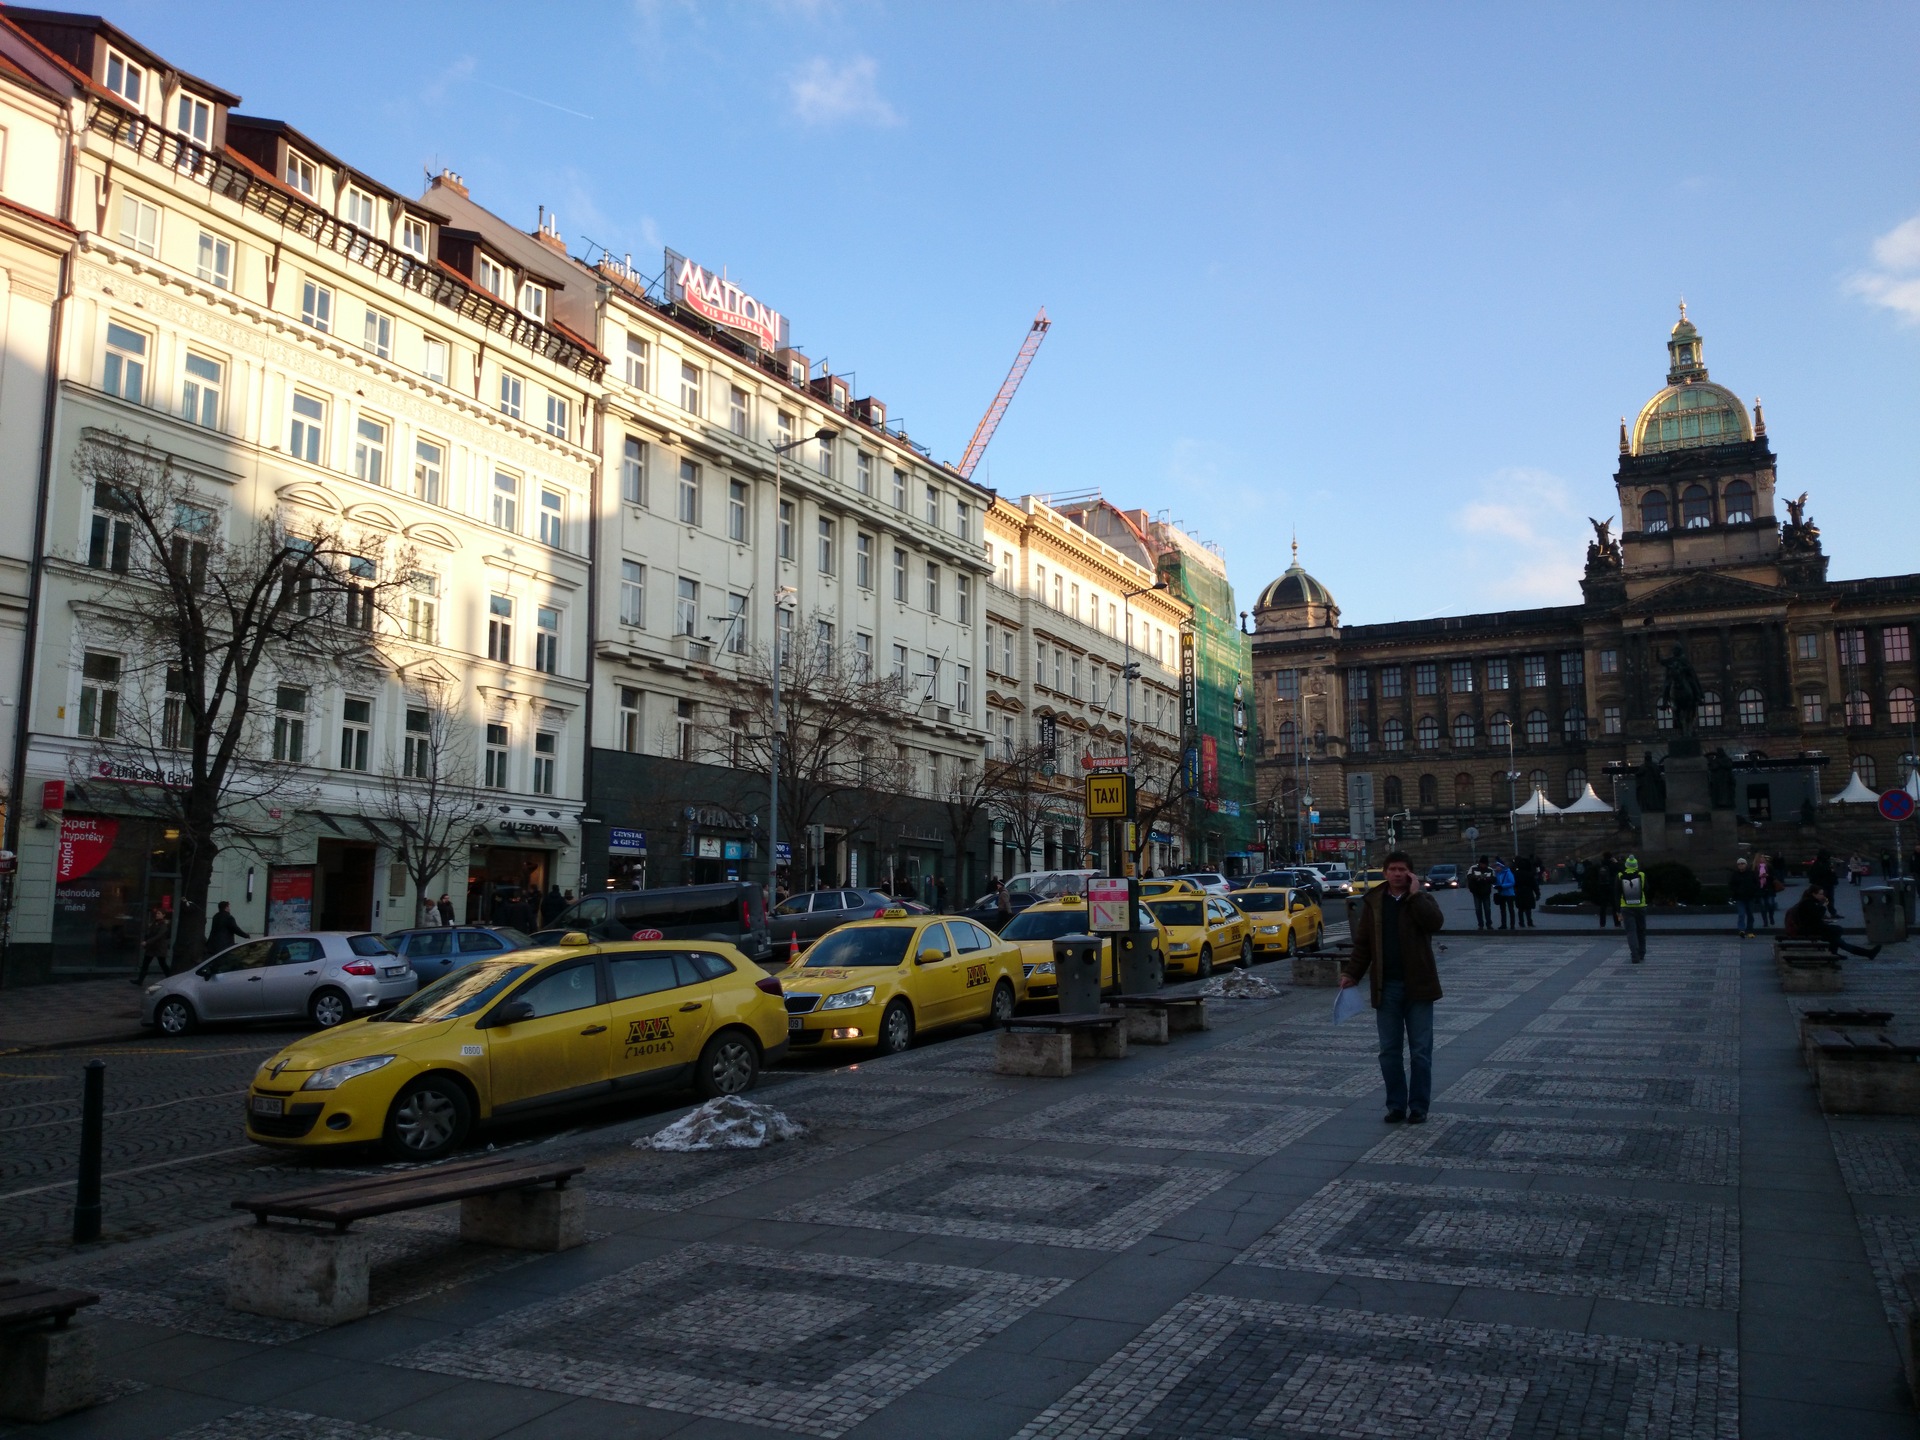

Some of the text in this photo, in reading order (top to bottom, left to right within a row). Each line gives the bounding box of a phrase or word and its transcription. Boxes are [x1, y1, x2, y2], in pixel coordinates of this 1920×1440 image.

[678, 258, 780, 342] MATTONI
[702, 304, 764, 336] VIS NATURAE
[1183, 650, 1194, 725] McDonald's
[1093, 758, 1127, 767] FAIR PLACE
[168, 770, 193, 785] Bank
[1094, 788, 1119, 804] TAXI
[697, 808, 751, 830] CHANGE
[500, 821, 559, 834] CALZEDONIA
[64, 831, 104, 844] hypotéky
[613, 831, 643, 840] CRYSTAL
[620, 839, 640, 847] GIFTS
[60, 842, 73, 876] půjčky
[57, 888, 100, 898] Jednoduše
[65, 903, 86, 911] méně
[638, 929, 658, 939] etc
[967, 964, 990, 988] AAA
[625, 1017, 674, 1044] AAA
